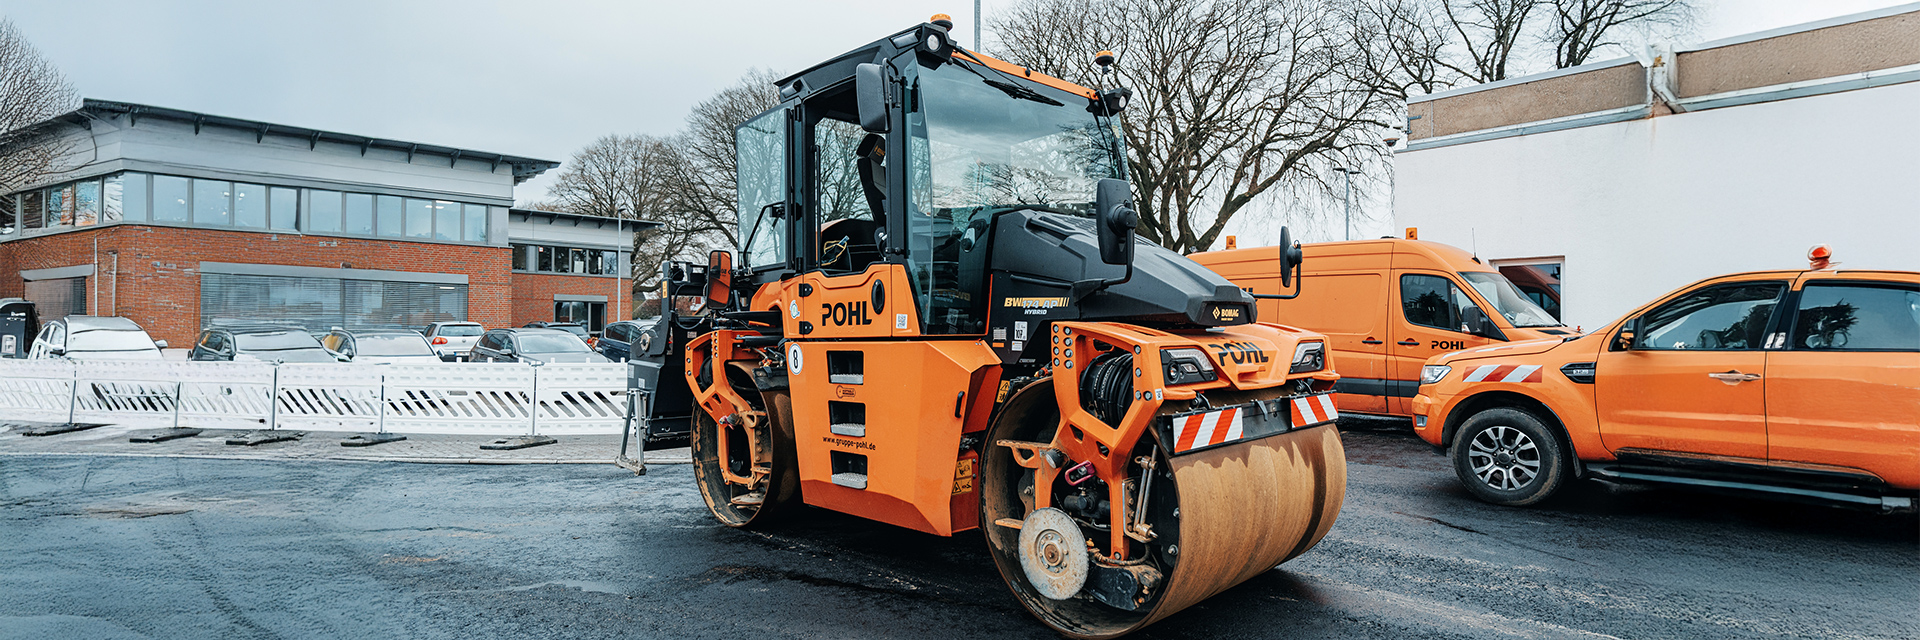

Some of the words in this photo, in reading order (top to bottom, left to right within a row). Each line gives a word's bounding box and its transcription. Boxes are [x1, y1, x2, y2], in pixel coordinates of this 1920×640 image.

[1004, 297, 1023, 307] BW
[1022, 300, 1039, 309] 174
[1042, 300, 1058, 309] AP
[822, 301, 872, 326] POHL
[1221, 309, 1239, 317] BOMAG
[1431, 340, 1467, 350] POHL
[793, 349, 799, 369] 8
[1208, 342, 1269, 366] POHL
[822, 436, 876, 450] www.gruppe-pohl.de
